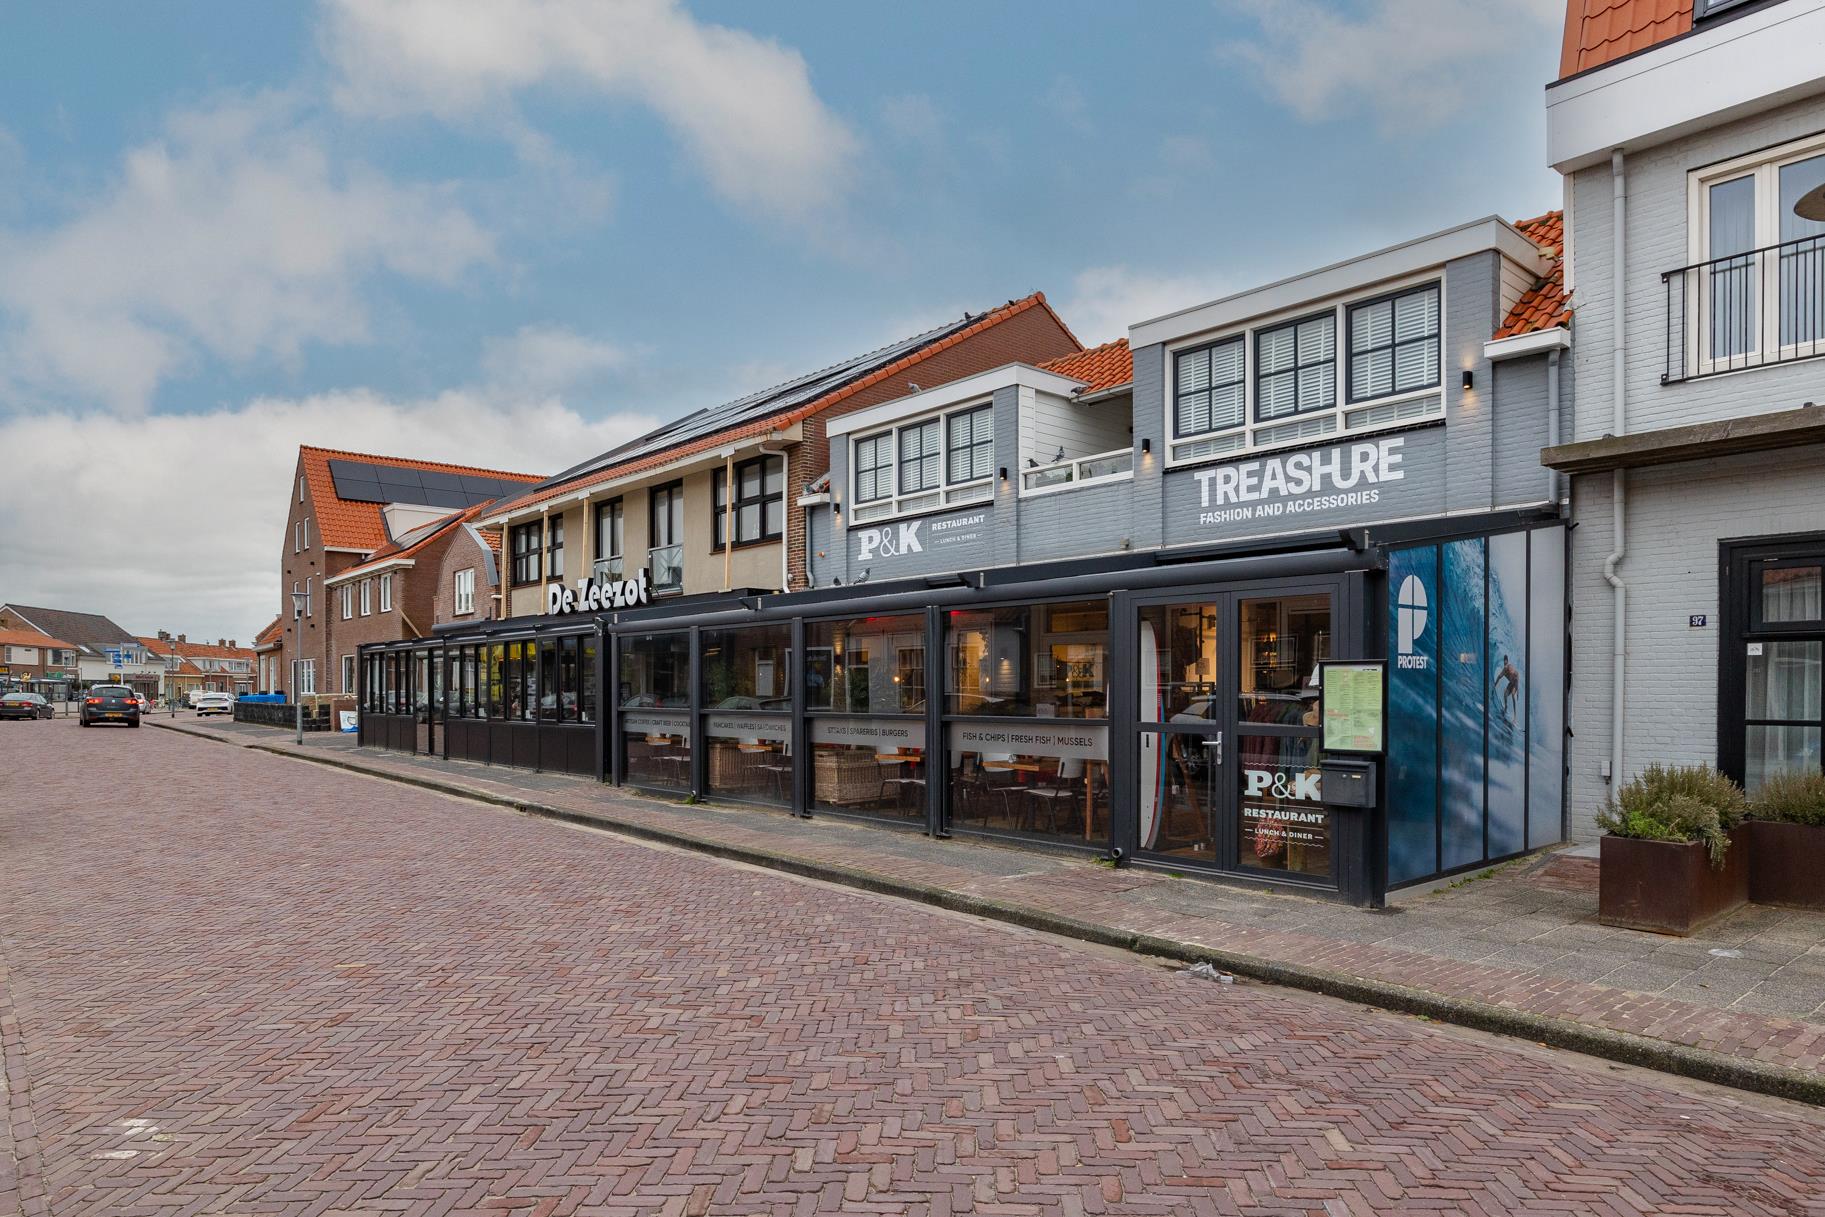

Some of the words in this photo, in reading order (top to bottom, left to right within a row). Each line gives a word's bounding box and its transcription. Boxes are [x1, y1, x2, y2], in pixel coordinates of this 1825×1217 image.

[1194, 437, 1405, 507] TREASHURE
[1200, 507, 1252, 525] FASHION
[1255, 503, 1283, 518] AND
[1286, 489, 1380, 514] ACCESSORIES
[931, 514, 986, 532] RESTAURANT
[858, 520, 924, 561] P&K
[940, 536, 956, 544] LUNCH
[961, 533, 977, 541] DINER
[548, 583, 574, 615] De
[577, 567, 648, 611] Zeezot
[1692, 615, 1704, 626] 97
[1397, 655, 1428, 670] PROTEST
[849, 727, 878, 736] SPARERIBS
[881, 729, 909, 737] BURGERS
[962, 732, 977, 741] FISH
[978, 732, 984, 741] &
[985, 732, 1006, 743] CHIPS
[1010, 734, 1034, 744] FRESH
[1035, 736, 1051, 745] FISH
[1057, 736, 1093, 747] MUSSELS
[1243, 769, 1322, 801] P&K
[1243, 807, 1325, 824] RESTAURANT
[1254, 828, 1281, 836] LUNCH
[1289, 831, 1313, 840] DINER
